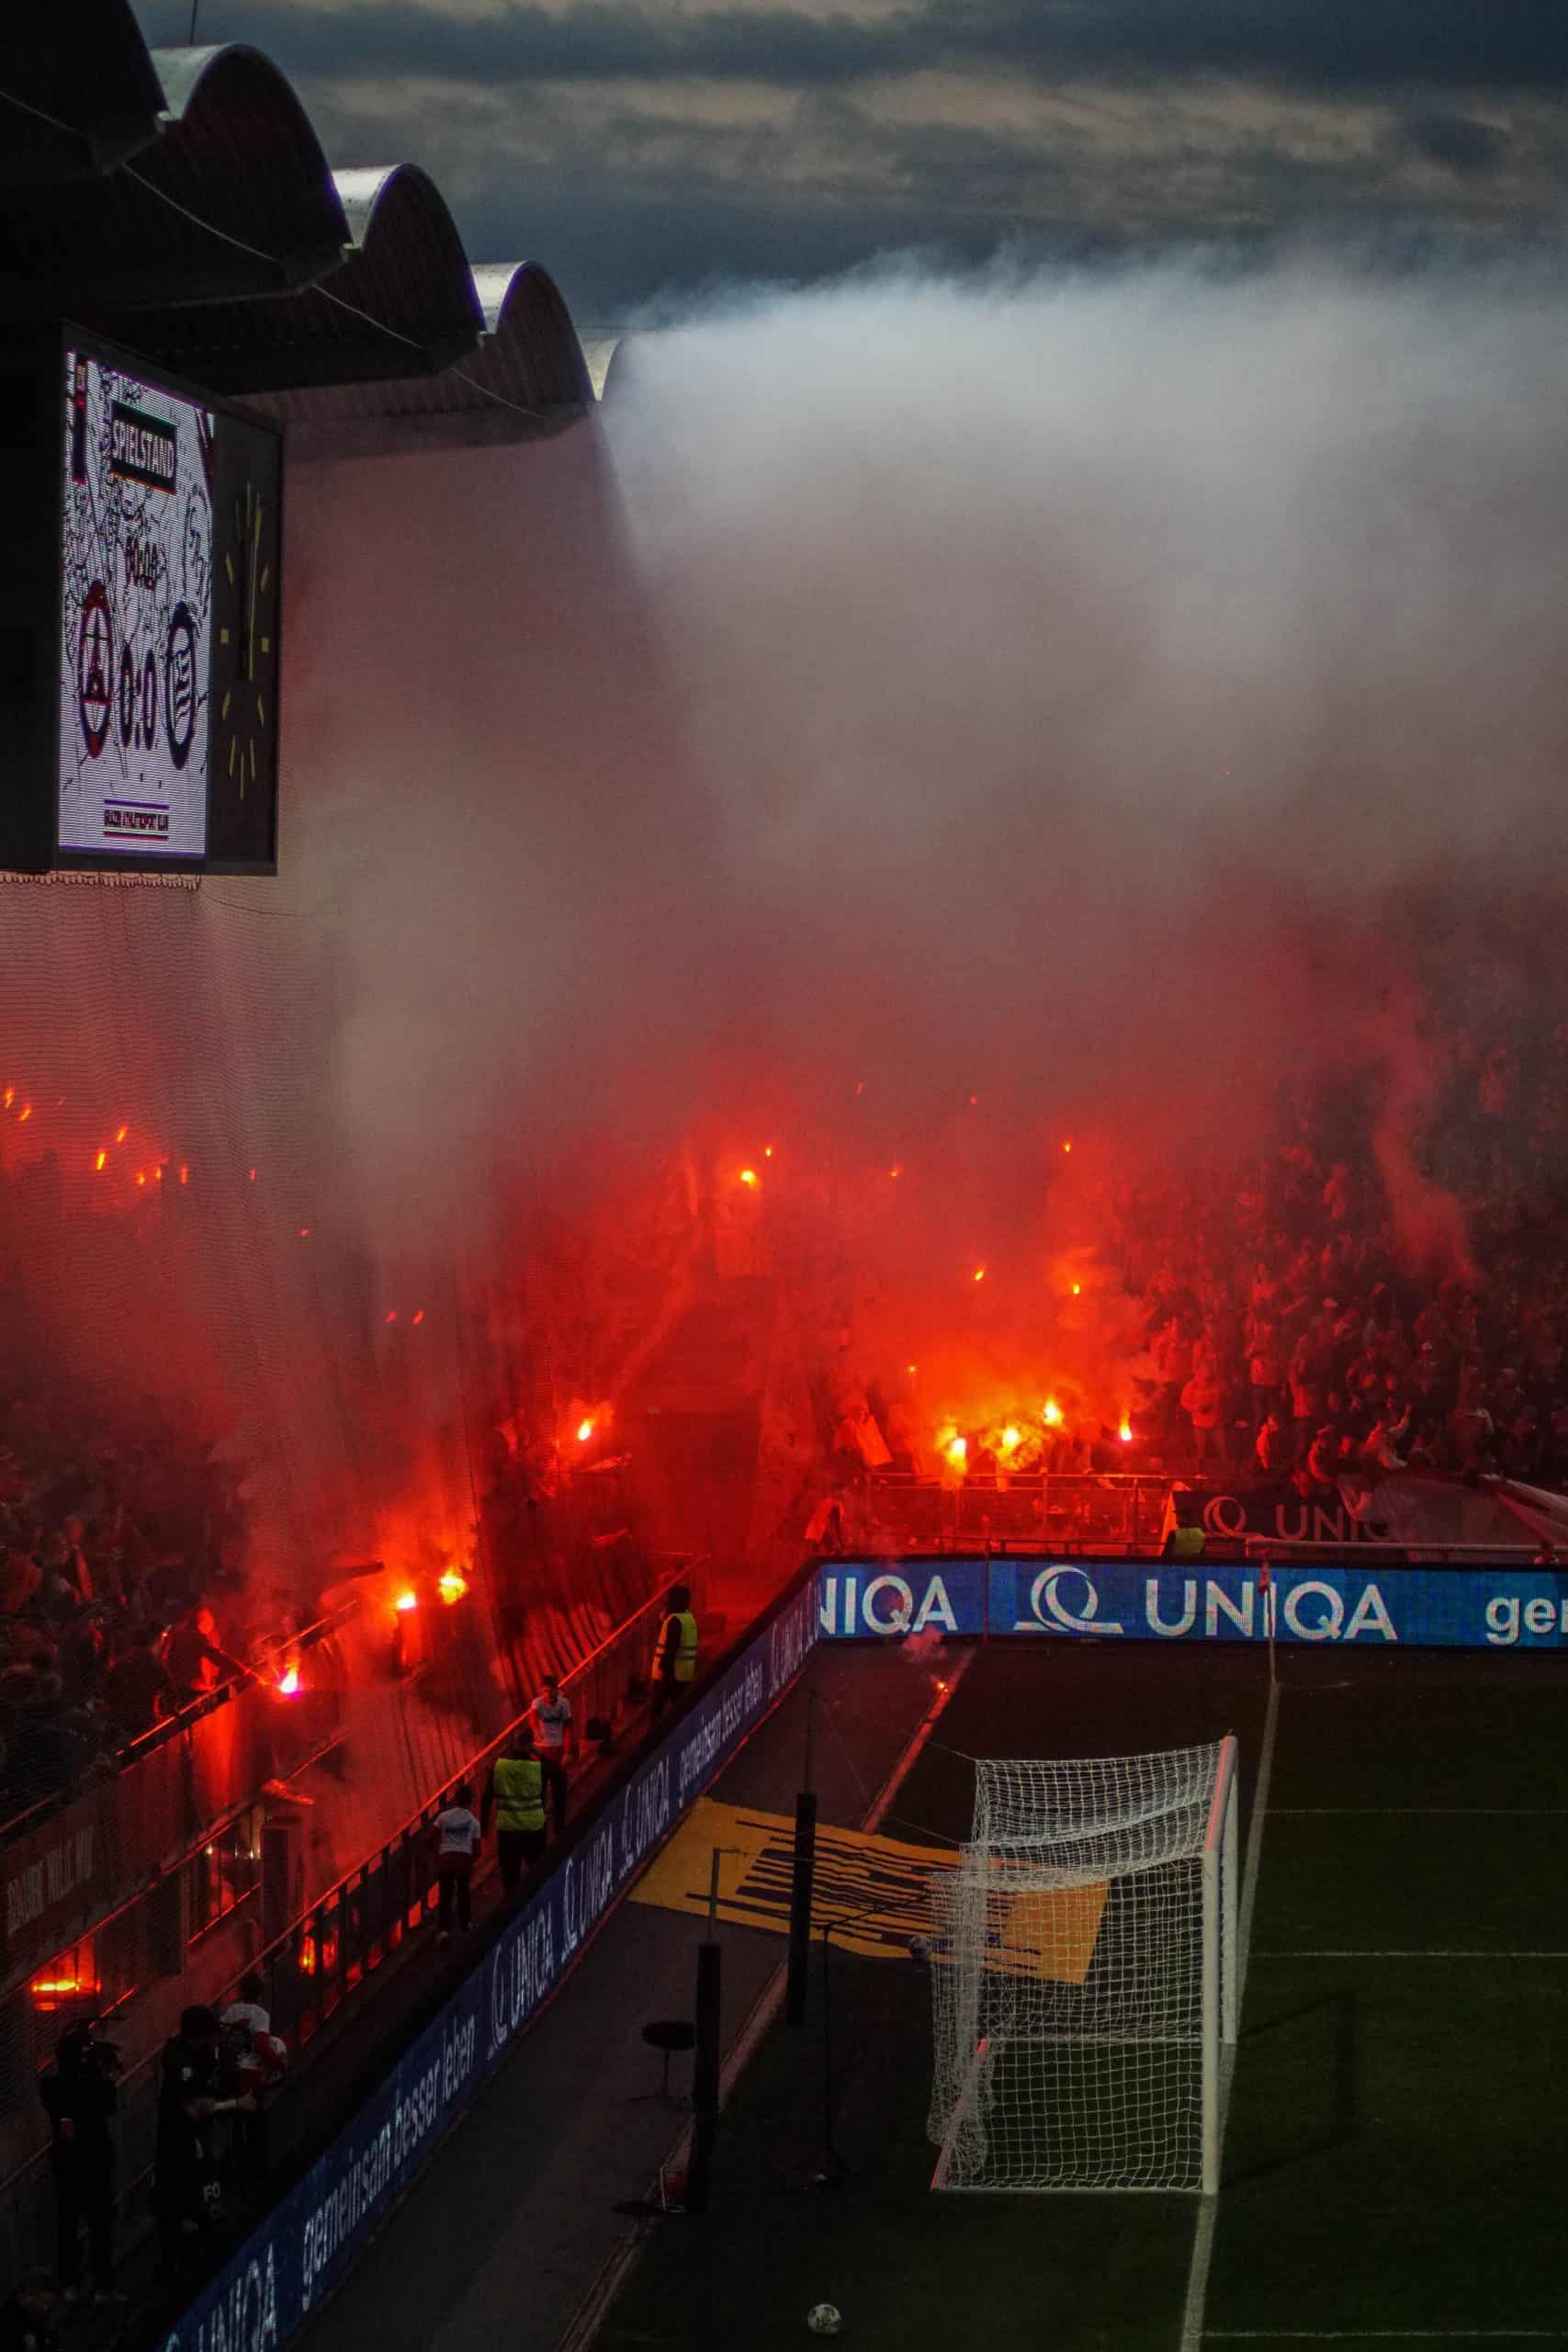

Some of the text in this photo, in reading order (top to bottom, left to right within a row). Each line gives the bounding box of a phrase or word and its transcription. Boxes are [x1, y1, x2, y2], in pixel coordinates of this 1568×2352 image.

[112, 419, 175, 479] SPIELSTAND
[120, 644, 157, 750] 0:0
[1145, 1577, 1398, 1642] UNIQA
[1484, 1597, 1568, 1646] ge
[510, 1900, 555, 2030] UNIQA
[301, 2013, 476, 2313] gemeinsam besser leben
